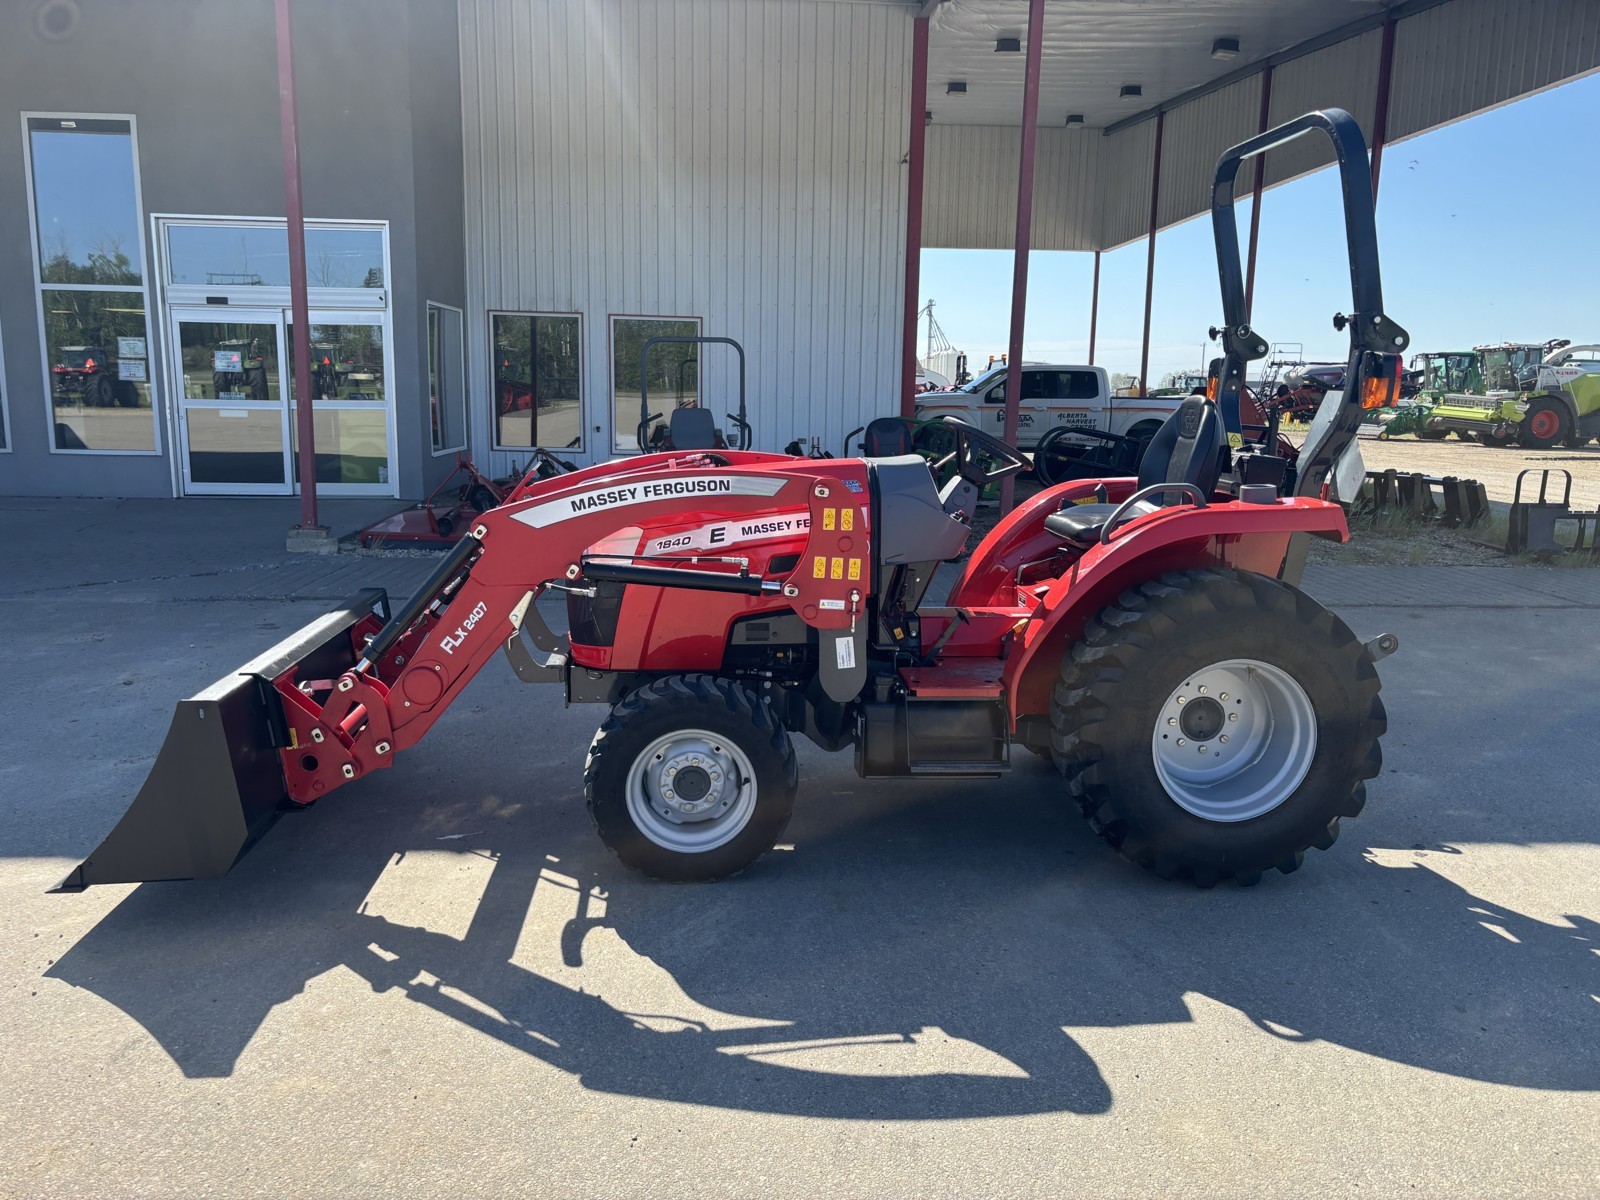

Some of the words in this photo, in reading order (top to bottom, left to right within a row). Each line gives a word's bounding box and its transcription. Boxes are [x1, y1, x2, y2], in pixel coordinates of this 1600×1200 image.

[571, 487, 638, 513] MASSEY
[643, 479, 731, 498] FERGUSON
[656, 536, 692, 550] 1840
[709, 526, 726, 544] E
[741, 521, 792, 536] MASSEY
[439, 627, 469, 655] FLX
[463, 601, 488, 631] 2407
